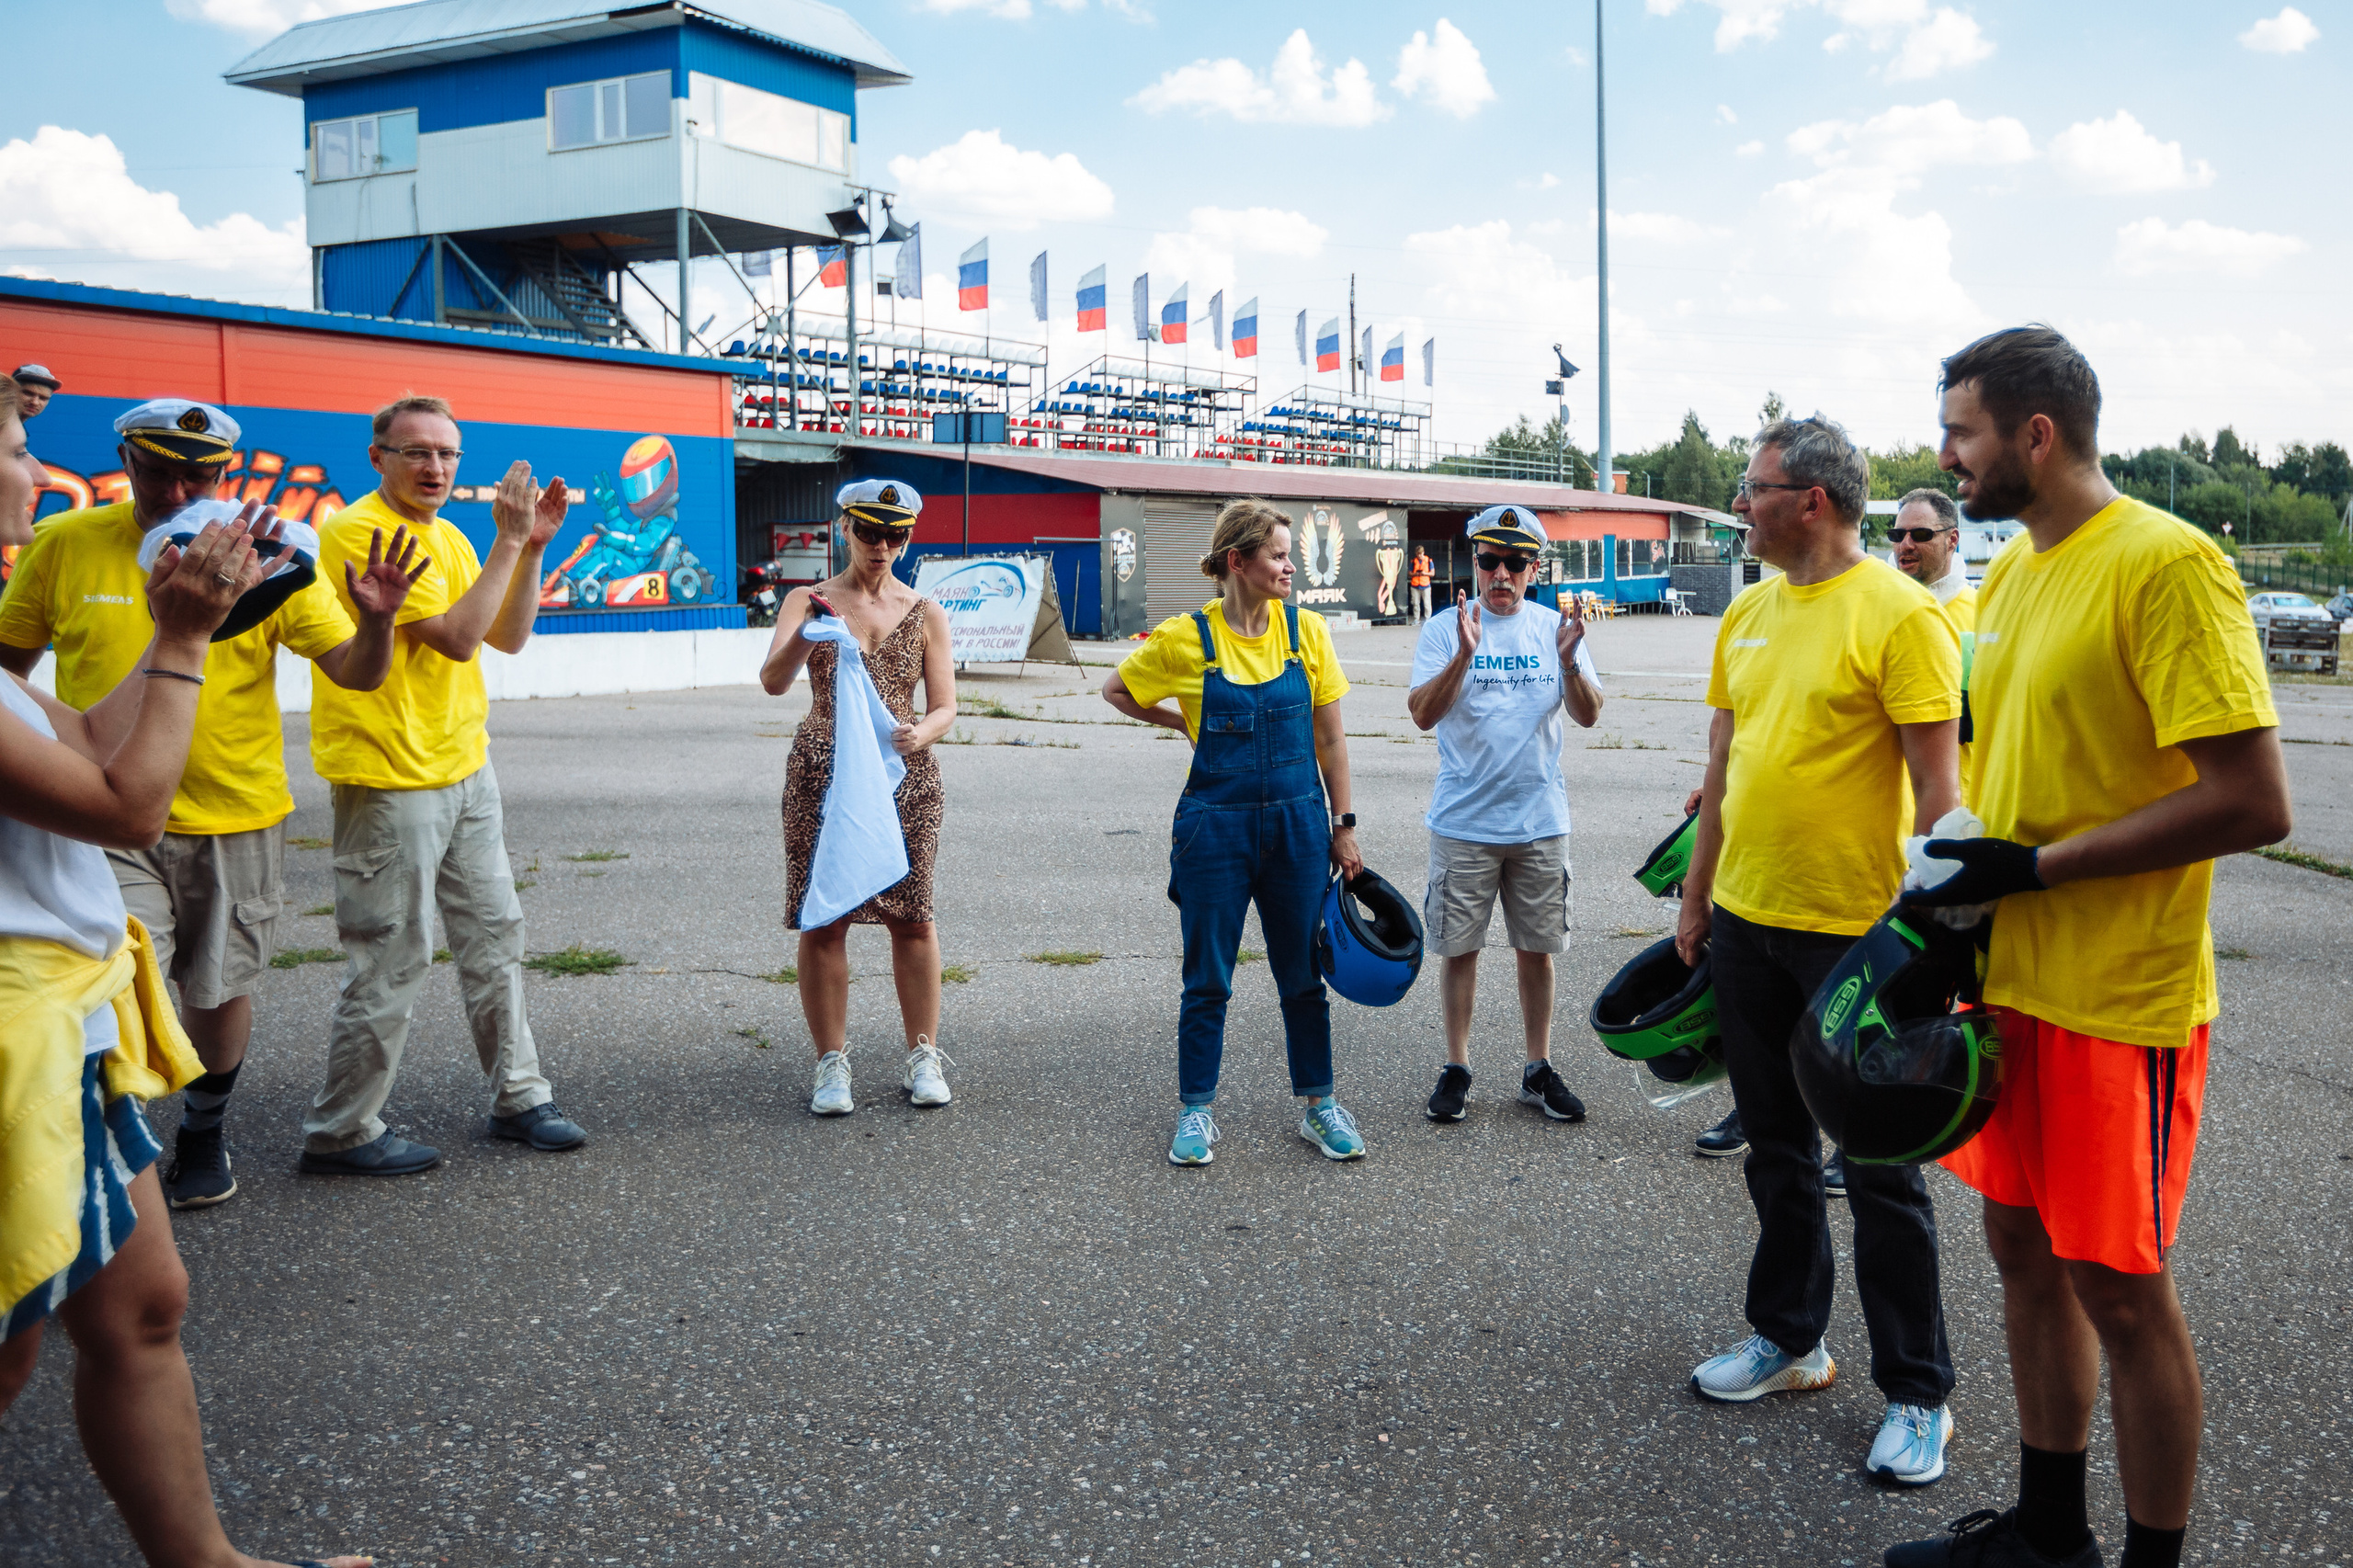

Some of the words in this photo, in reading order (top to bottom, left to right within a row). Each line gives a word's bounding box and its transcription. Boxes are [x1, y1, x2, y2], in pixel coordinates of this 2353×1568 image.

[648, 578, 659, 597] 8
[931, 587, 970, 599] МАЯК
[1296, 588, 1347, 604] МАЯК
[939, 598, 987, 612] РТИНГ
[950, 624, 1025, 636] ССИОНАЛЬНЫЙ
[966, 639, 974, 648] В
[1469, 655, 1540, 671] EMENS
[1472, 674, 1519, 691] Ingenuity
[1520, 674, 1538, 686] for
[1539, 674, 1555, 685] life
[1826, 983, 1856, 1028] GSB
